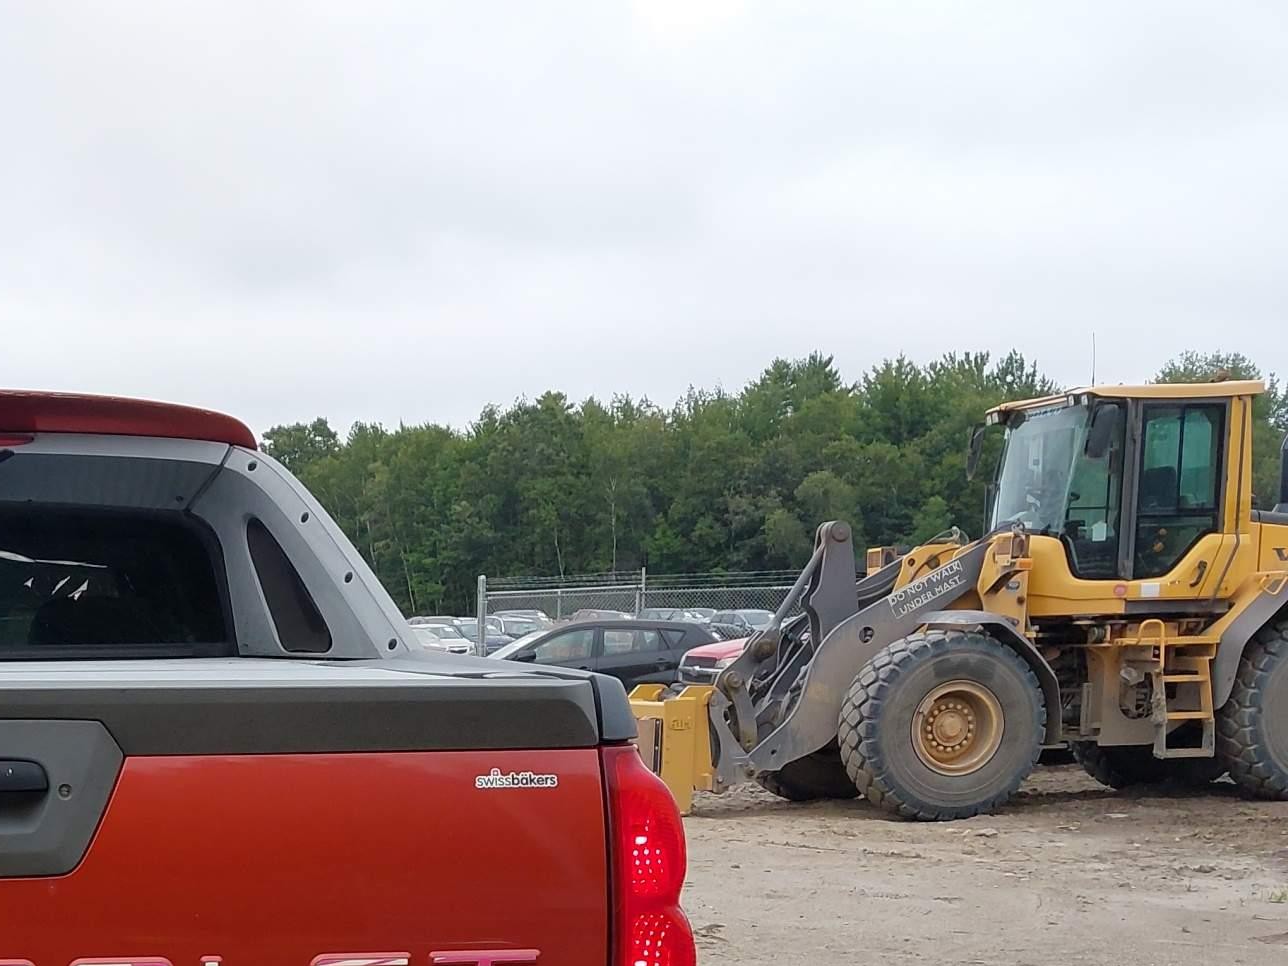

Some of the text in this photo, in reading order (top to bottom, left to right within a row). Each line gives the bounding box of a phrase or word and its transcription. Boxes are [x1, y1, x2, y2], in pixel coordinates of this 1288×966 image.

[888, 560, 961, 606] DO NOT WALK
[899, 575, 961, 615] UNDER MAST
[477, 770, 556, 787] swissbäkers
